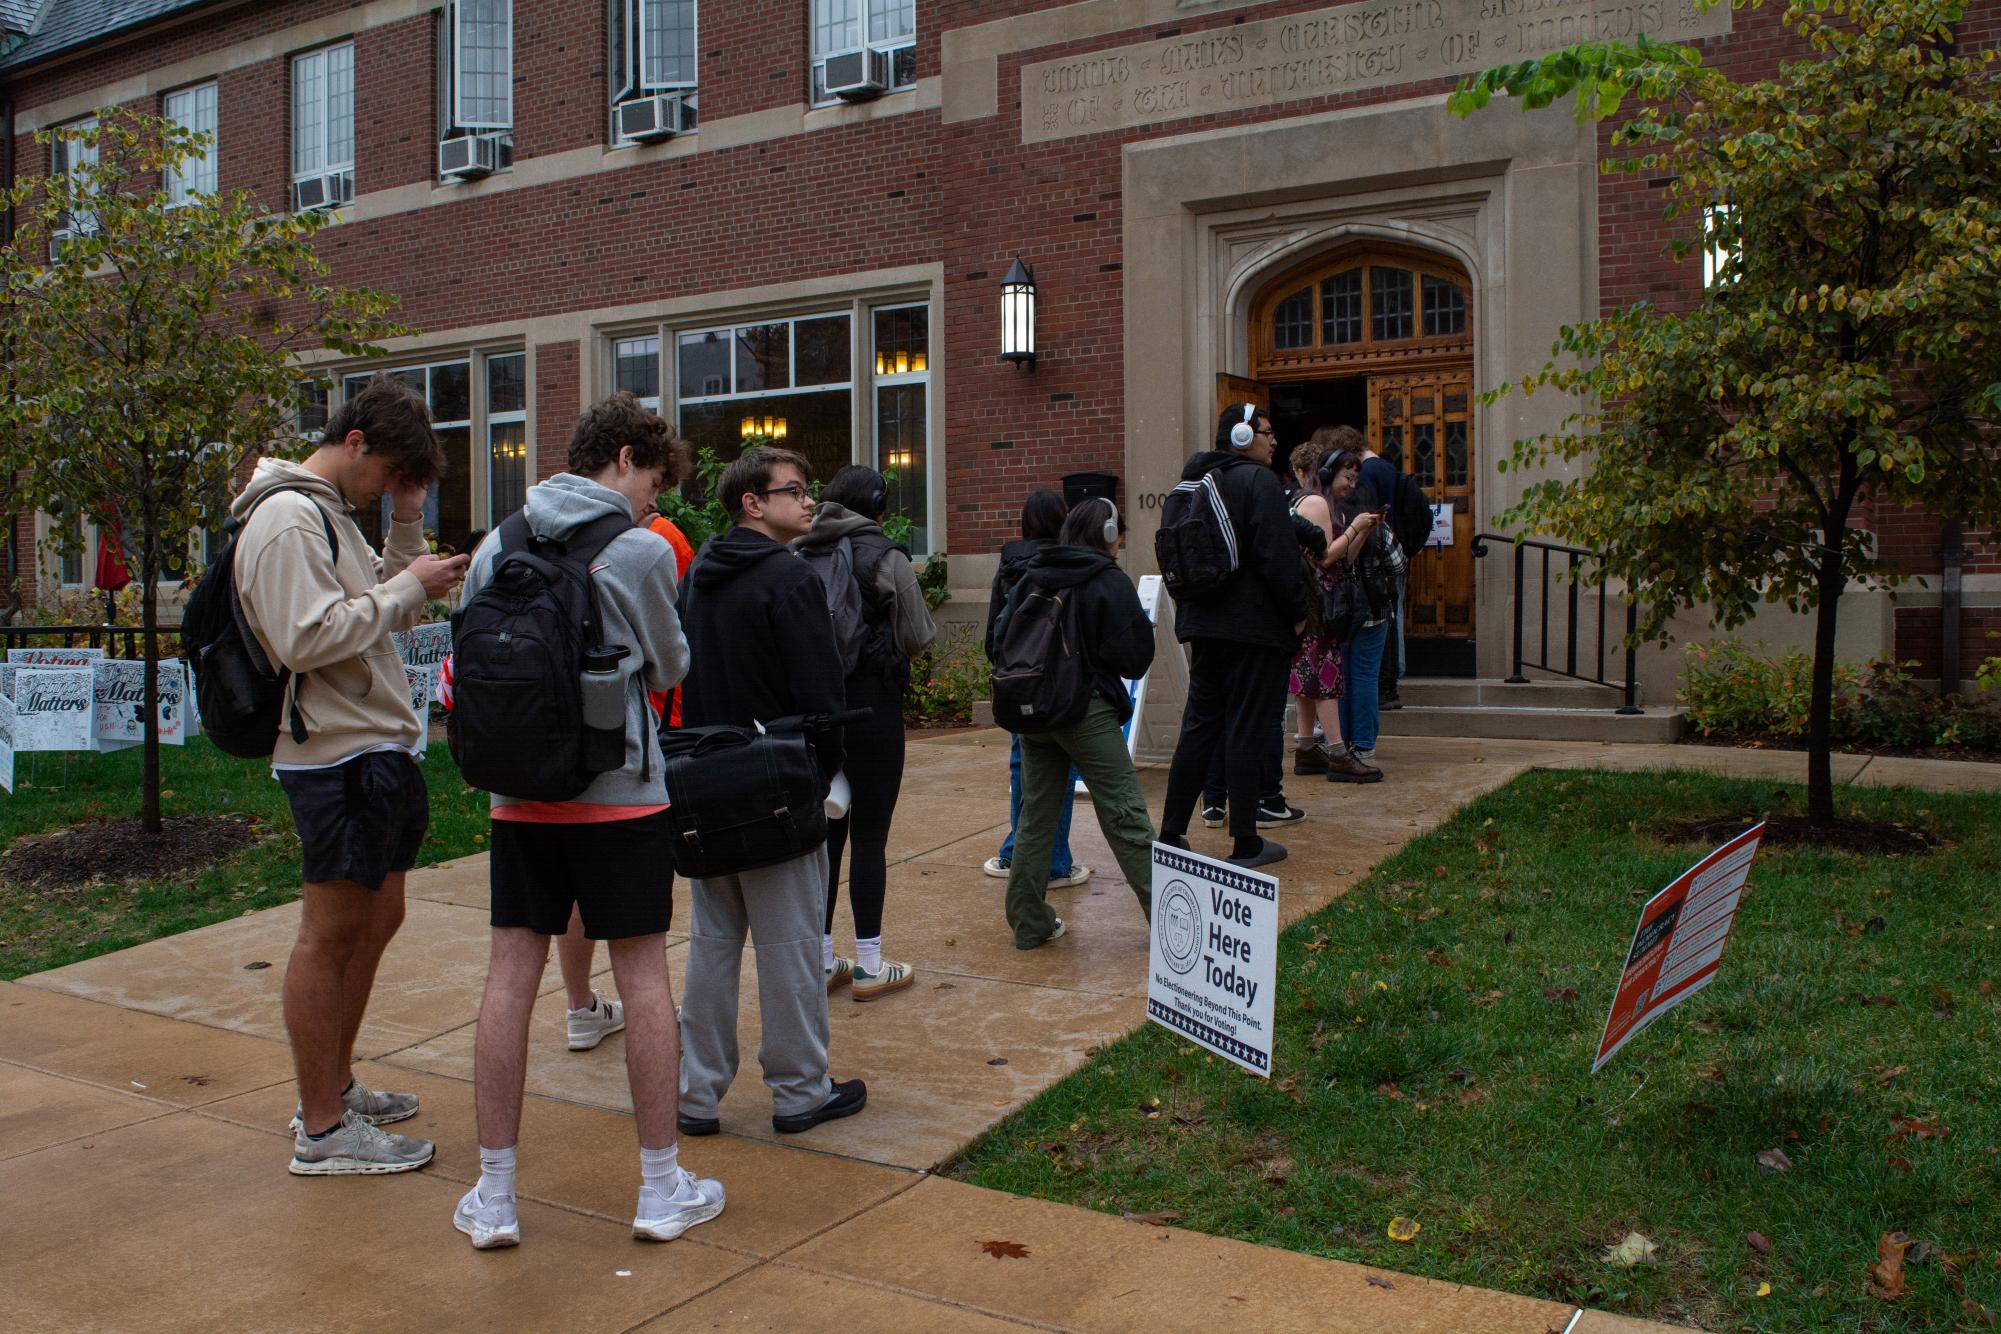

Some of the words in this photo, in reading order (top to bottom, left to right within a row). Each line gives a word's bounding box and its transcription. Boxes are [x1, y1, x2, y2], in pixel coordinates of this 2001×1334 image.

[18, 692, 88, 713] Matters
[1211, 886, 1252, 927] Vote
[1209, 922, 1251, 963] Here
[1155, 973, 1163, 985] No
[1163, 978, 1203, 1007] Electioneering
[1203, 998, 1227, 1015] Beyond
[1228, 1007, 1241, 1022] This
[1242, 1014, 1262, 1031] Point.
[1203, 955, 1258, 1008] Today
[1174, 997, 1192, 1013] Thank
[1192, 1008, 1204, 1020] you
[1204, 1011, 1213, 1024] for
[1214, 1016, 1237, 1036] Voting!
